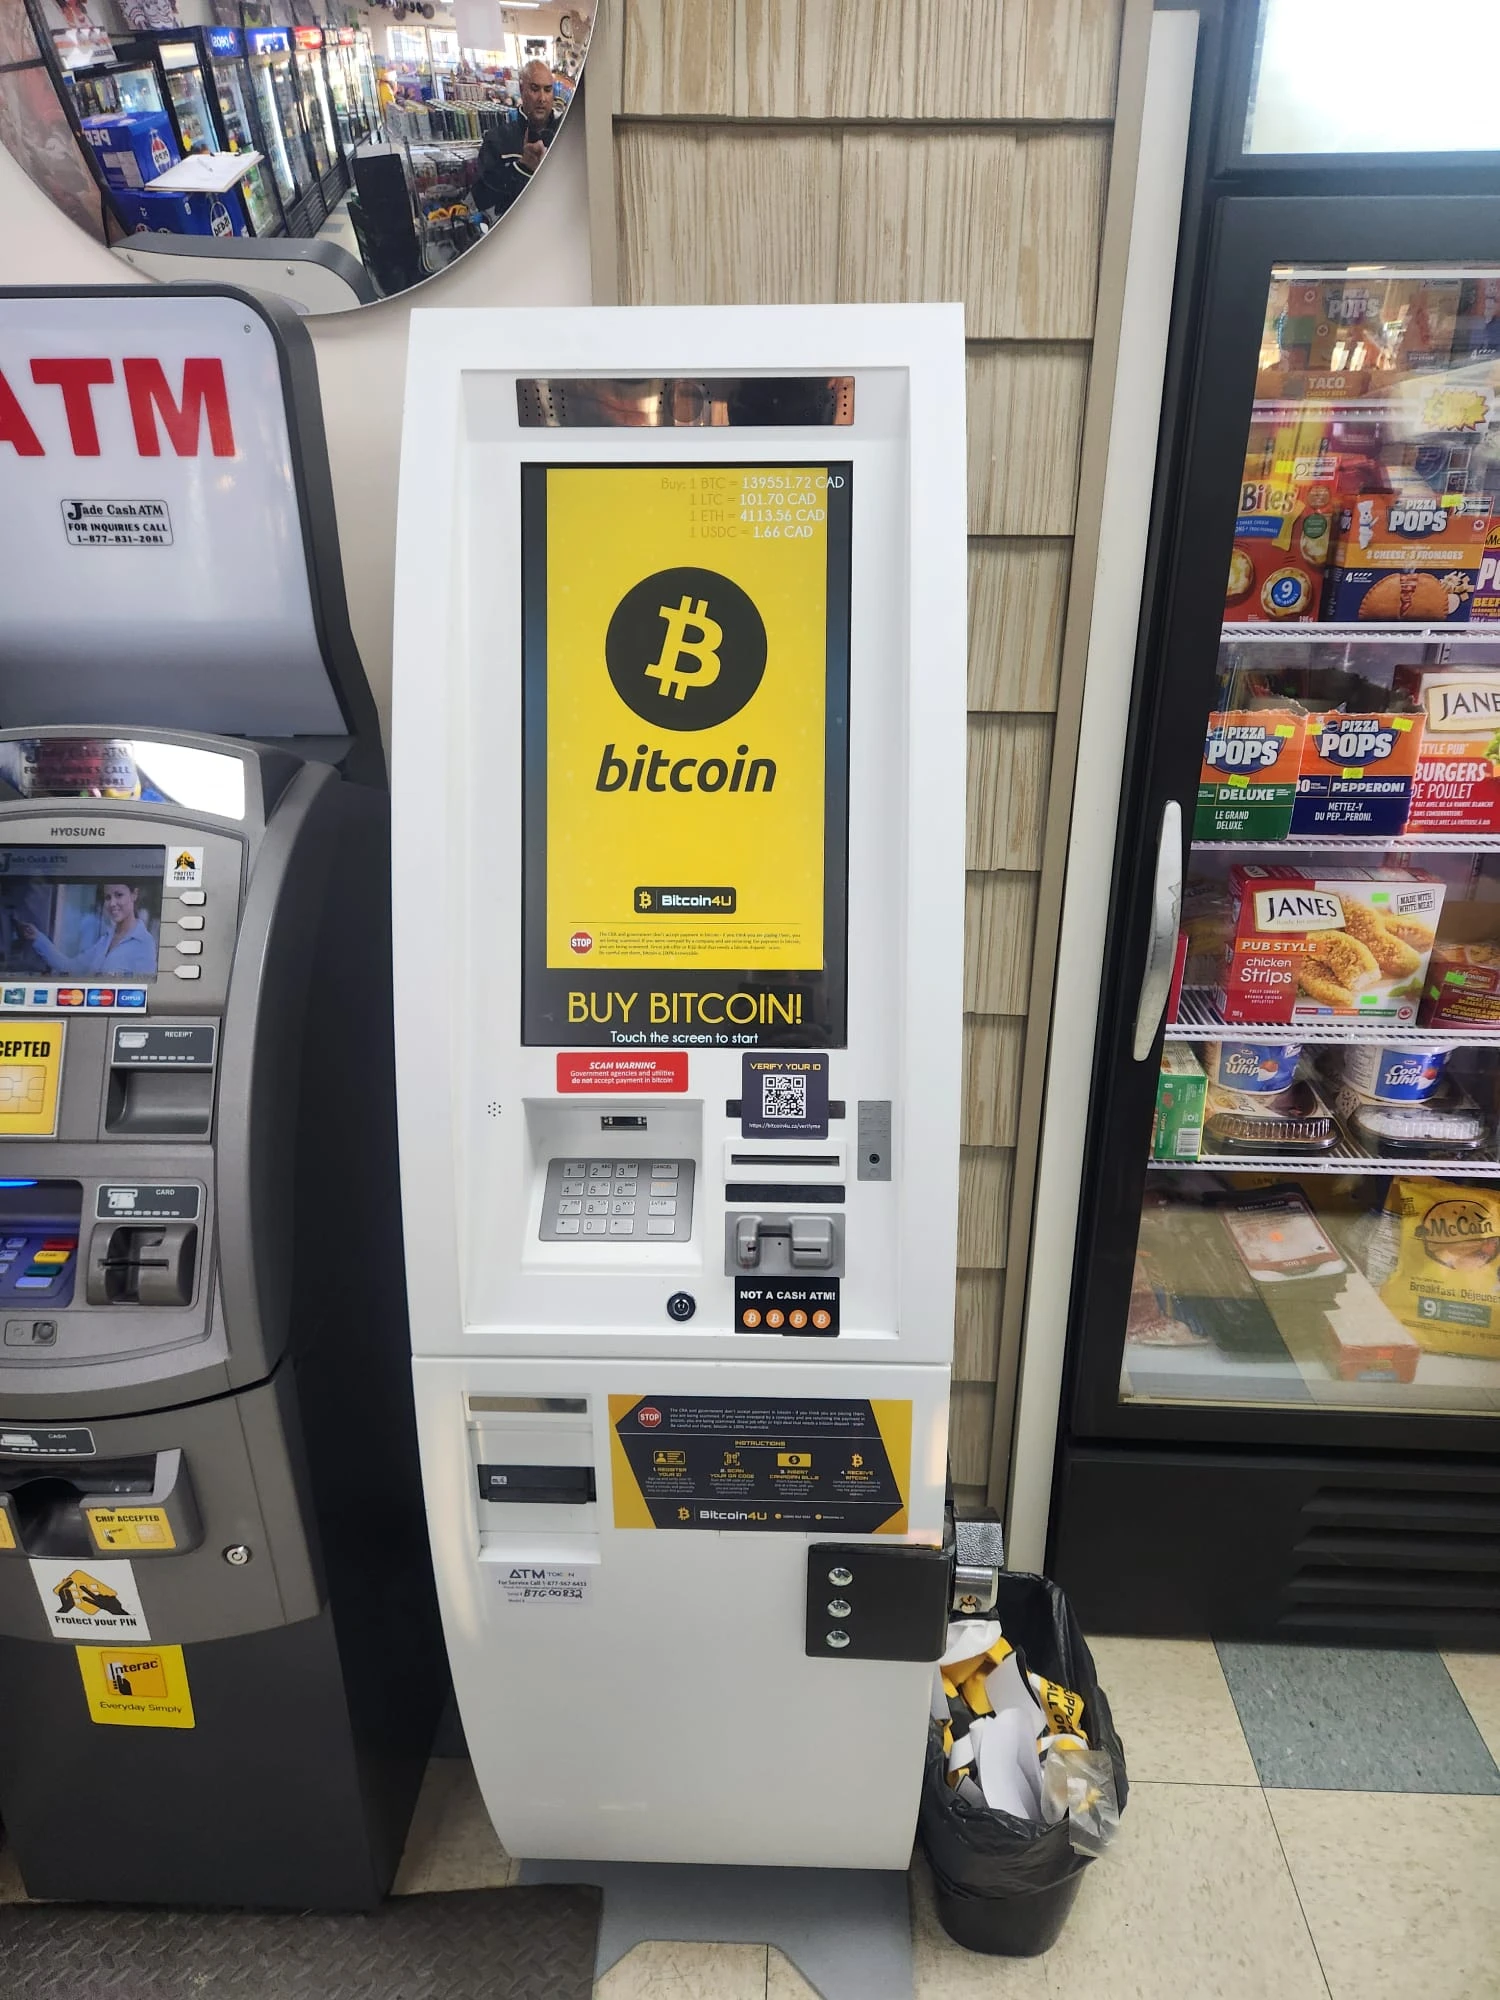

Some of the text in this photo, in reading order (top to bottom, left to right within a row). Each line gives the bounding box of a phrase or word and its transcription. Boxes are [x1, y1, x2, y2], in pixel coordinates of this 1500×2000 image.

[1328, 299, 1380, 318] POPS
[1309, 377, 1345, 389] TACO
[701, 477, 726, 489] BTC
[742, 477, 811, 489] 139551.72
[815, 476, 844, 489] CAD
[701, 494, 723, 506] LTC
[740, 493, 784, 505] 101.70
[787, 493, 816, 505] CAD
[1241, 483, 1298, 514] Bites
[67, 502, 164, 520] Jade Cash ATM
[1405, 500, 1437, 510] PIZZA
[701, 510, 725, 522] ETH
[740, 510, 791, 522] 4113.56
[796, 510, 825, 521] CAD
[1388, 511, 1448, 532] POPS
[68, 523, 168, 532] FOR INQUIRIES CALL
[701, 526, 737, 538] USDC
[753, 526, 780, 538] 1.66
[784, 526, 813, 538] CAD
[76, 534, 164, 544] 1-877-831-2081
[1374, 551, 1407, 560] CHEESE
[1417, 551, 1464, 560] FROMAGES
[1345, 572, 1353, 583] 4
[1281, 580, 1293, 598] 9
[1341, 720, 1379, 733] PIZZA
[1227, 726, 1266, 740] PIZZA
[1320, 733, 1394, 758] POPS
[1206, 740, 1279, 766] POPS
[595, 743, 777, 793] bitcoin
[1413, 762, 1487, 782] BURGERS
[1331, 782, 1405, 793] PEPPERONI
[1427, 783, 1474, 799] POULET
[1219, 788, 1275, 801] DELUXE
[1328, 802, 1364, 811] METTEZ-Y
[1215, 810, 1250, 820] LE GRAND
[1315, 811, 1325, 821] DU
[1216, 821, 1244, 830] DELUXE.
[50, 827, 106, 838] HYOSUNG
[661, 893, 732, 908] Bitcoin4U
[1400, 892, 1433, 905] MADE WITH
[1265, 897, 1338, 922] JANES
[571, 938, 592, 948] STOP
[1241, 941, 1317, 952] PUB STYLE
[1246, 957, 1292, 968] chicken
[1240, 968, 1292, 986] Strips
[567, 991, 803, 1025] BUY BITCOIN!
[610, 1030, 759, 1044] Touch the screen to start
[1229, 1053, 1260, 1065] Cool
[589, 1061, 657, 1070] SCAM WARNING
[786, 1063, 810, 1071] YOUR
[812, 1063, 821, 1071] ID
[1225, 1062, 1261, 1076] Whip
[1390, 1064, 1422, 1076] Cool
[616, 1077, 644, 1085] payment
[1384, 1073, 1421, 1087] Whip
[567, 1168, 572, 1176] 1
[592, 1168, 598, 1176] 2
[618, 1168, 625, 1176] 3
[563, 1186, 570, 1194] 4
[589, 1186, 596, 1194] 5
[617, 1186, 623, 1194] 6
[562, 1205, 568, 1213] 7
[588, 1205, 594, 1213] 8
[615, 1205, 621, 1213] 9
[586, 1222, 592, 1230] 0
[1429, 1215, 1495, 1237] McCain
[740, 1290, 836, 1301] NOT A CASH ATM!
[1409, 1281, 1457, 1298] Breakfast
[1423, 1300, 1437, 1317] 9
[640, 1413, 660, 1421] STOP
[95, 1515, 116, 1523] CHIP
[699, 1509, 768, 1521] Bitcoin4U
[509, 1569, 546, 1579] ATM
[55, 1615, 137, 1628] Protect your PIN
[109, 1660, 159, 1677] Interac
[100, 1701, 182, 1714] Everyday Simply
